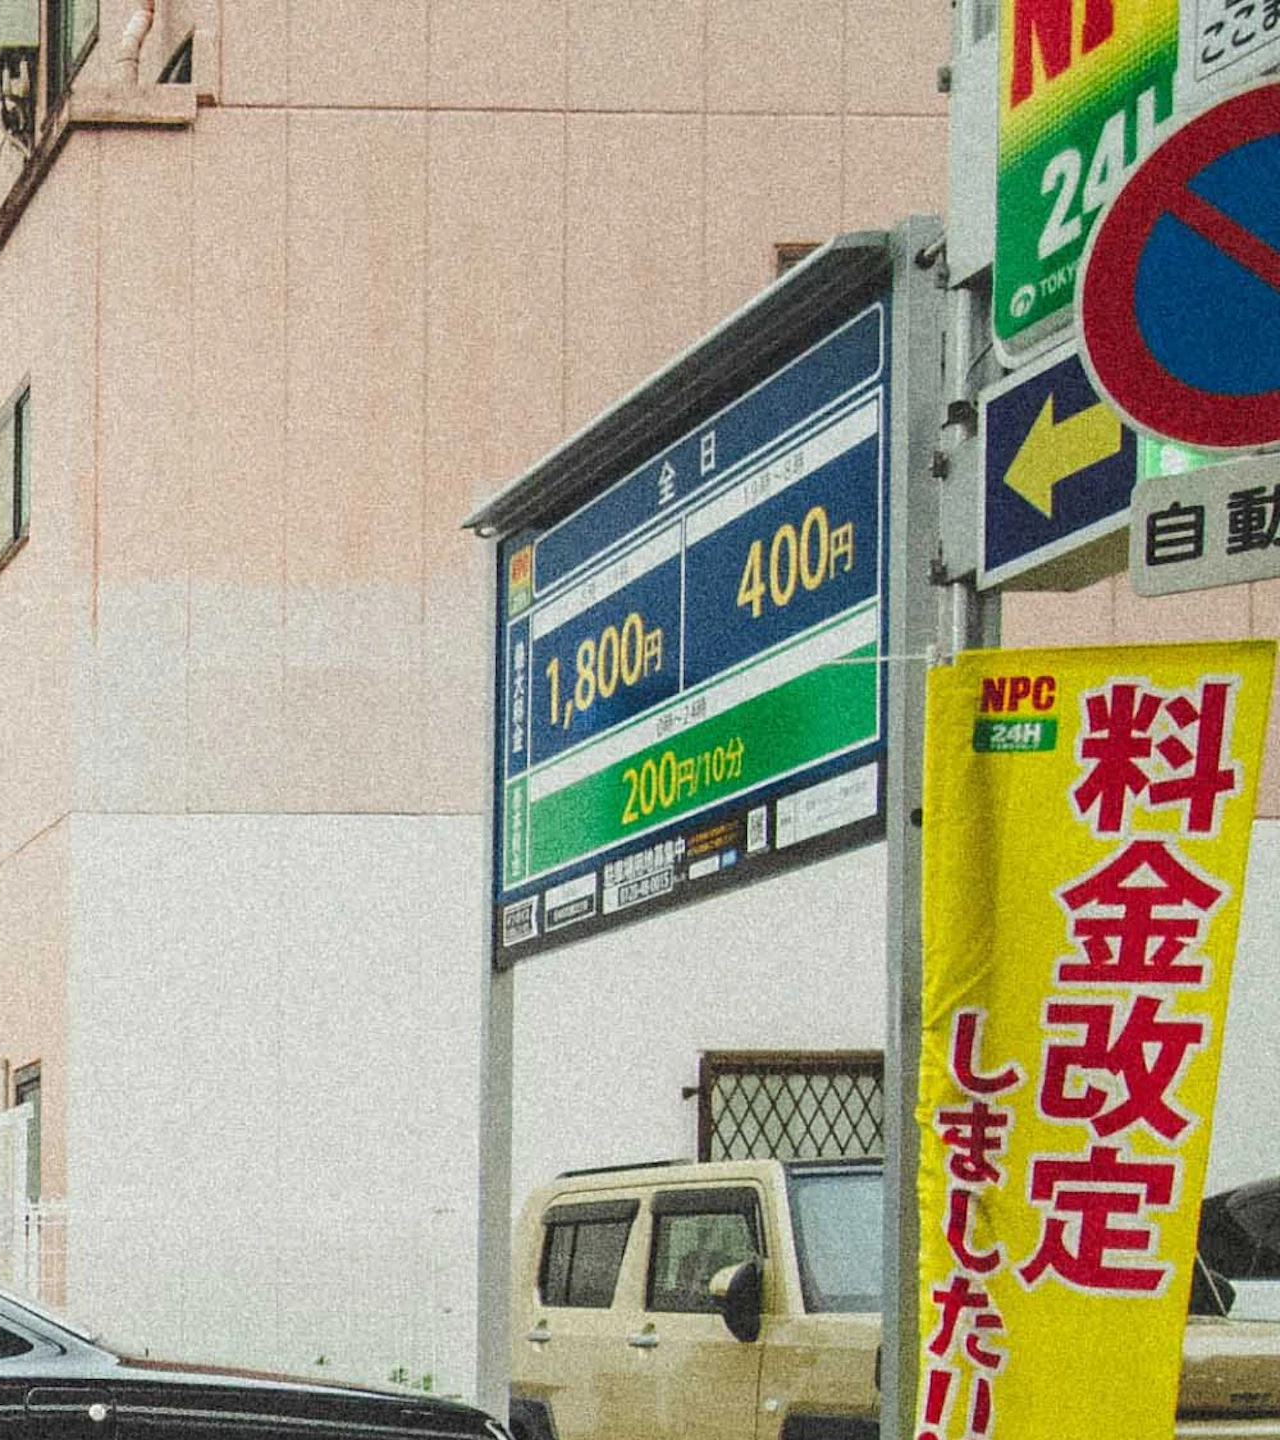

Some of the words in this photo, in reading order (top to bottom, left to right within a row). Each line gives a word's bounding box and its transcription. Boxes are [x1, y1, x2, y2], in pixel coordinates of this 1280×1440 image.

[658, 430, 716, 505] 全日
[737, 505, 853, 618] 400円
[546, 613, 661, 731] 1,800円
[980, 676, 1057, 713] NPC
[989, 722, 1042, 743] 24H
[621, 736, 744, 824] 200円/10分
[1020, 683, 1235, 1292] 料金改定
